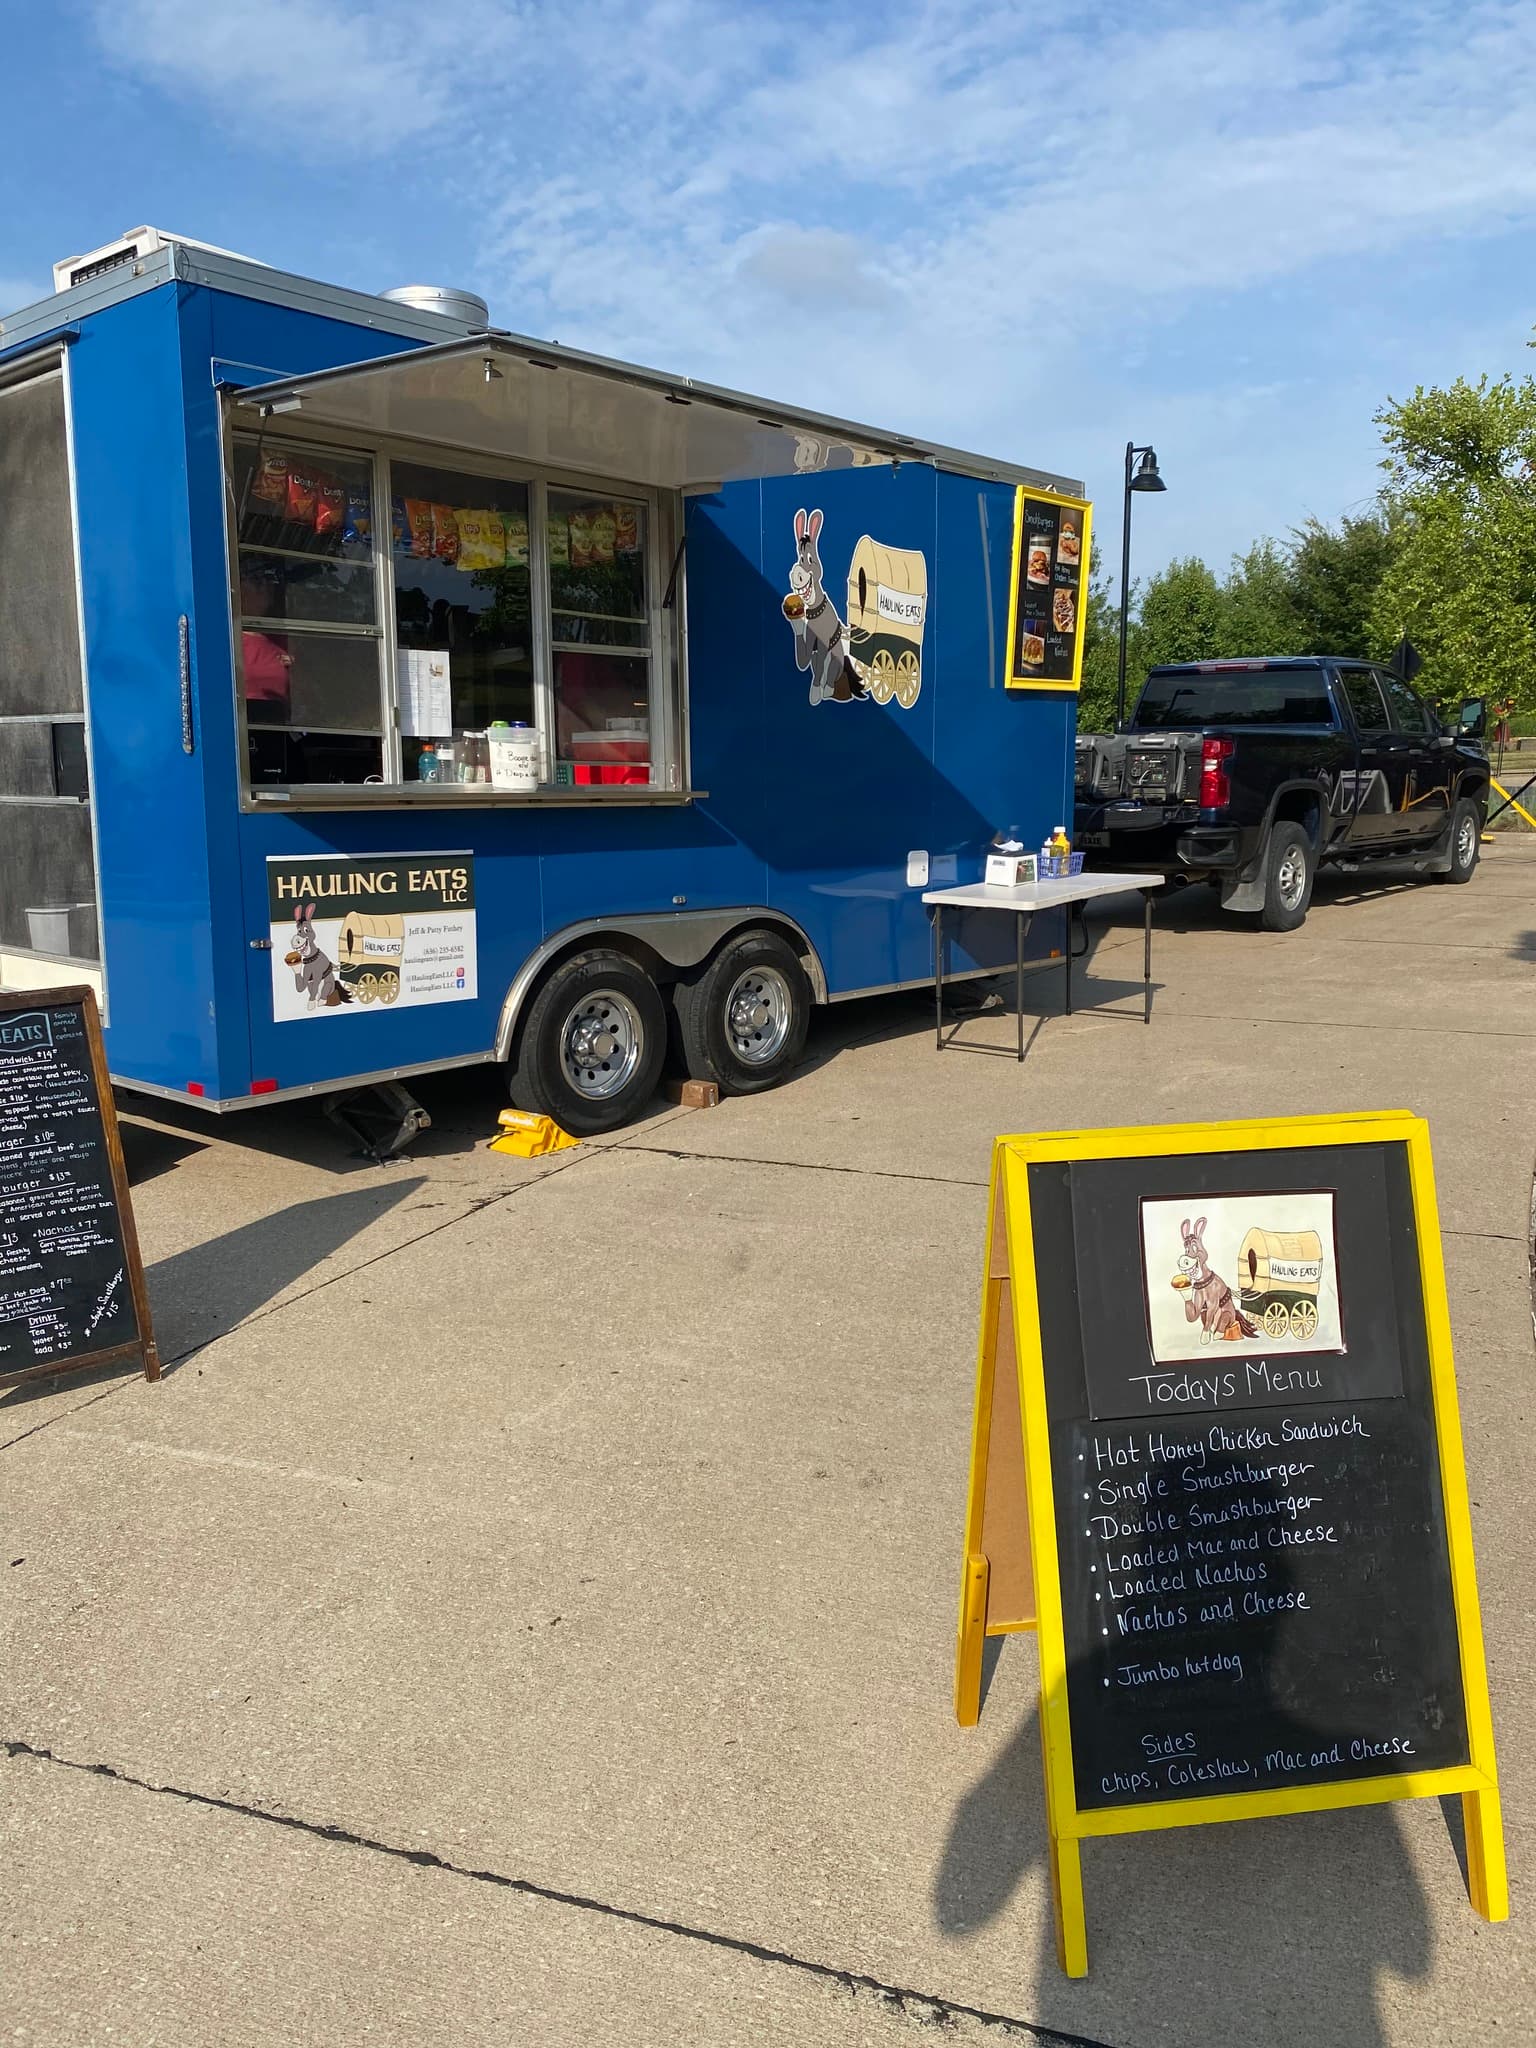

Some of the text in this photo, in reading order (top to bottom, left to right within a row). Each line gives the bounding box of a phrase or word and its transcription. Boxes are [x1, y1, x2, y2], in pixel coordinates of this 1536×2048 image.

[880, 593, 921, 618] HAULING EATS
[277, 867, 468, 899] HAULING EATS
[442, 889, 468, 903] LLC
[365, 940, 401, 953] HAULING EATS
[1, 1024, 43, 1044] EATS
[46, 1071, 60, 1080] and
[2, 1180, 41, 1193] burger
[10, 1201, 46, 1213] American
[46, 1209, 57, 1218] on
[38, 1225, 76, 1237] Nachos
[1271, 1263, 1318, 1277] HAULING EATS
[13, 1290, 27, 1299] Hot
[29, 1286, 47, 1296] Dog
[28, 1313, 57, 1326] Drinks
[28, 1328, 46, 1337] Tea
[1128, 1360, 1323, 1406] Todays Menu
[1095, 1414, 1371, 1471] Hot Honey Chicken Sandwich
[1098, 1461, 1315, 1505] Single Smashburger
[1090, 1495, 1323, 1540] Double Smashburger
[1106, 1524, 1338, 1573] Loaded Mac and Cheese
[1109, 1560, 1267, 1600] Loaded Nachos
[1116, 1589, 1311, 1636] Nachos and Cheese
[1117, 1660, 1180, 1688] Jumbo
[1141, 1731, 1197, 1757] Sides
[1167, 1760, 1260, 1787] Coleslaw,
[1266, 1751, 1306, 1772] Mac
[1310, 1748, 1344, 1767] and
[1350, 1735, 1417, 1762] Cheese
